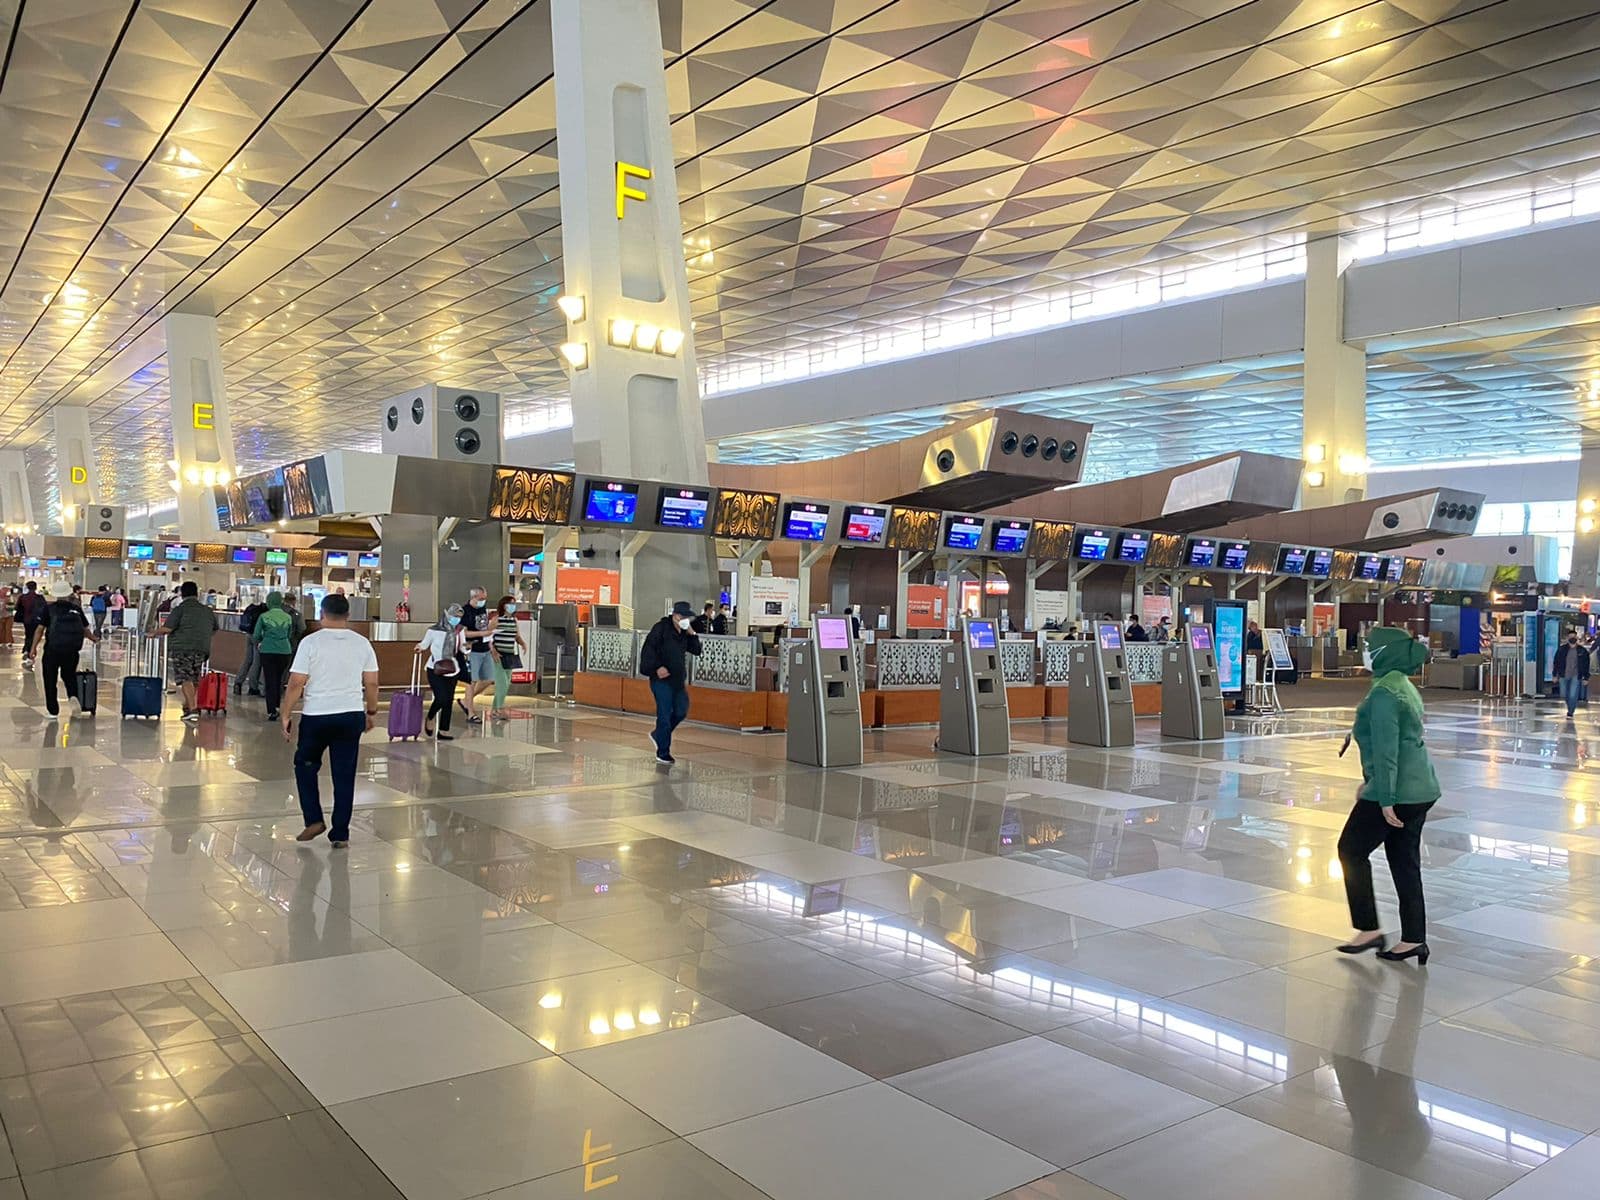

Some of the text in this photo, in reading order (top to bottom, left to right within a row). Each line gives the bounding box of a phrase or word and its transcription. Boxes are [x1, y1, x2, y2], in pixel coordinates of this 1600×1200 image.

[615, 161, 651, 220] F
[193, 403, 214, 430] E
[71, 466, 87, 484] D
